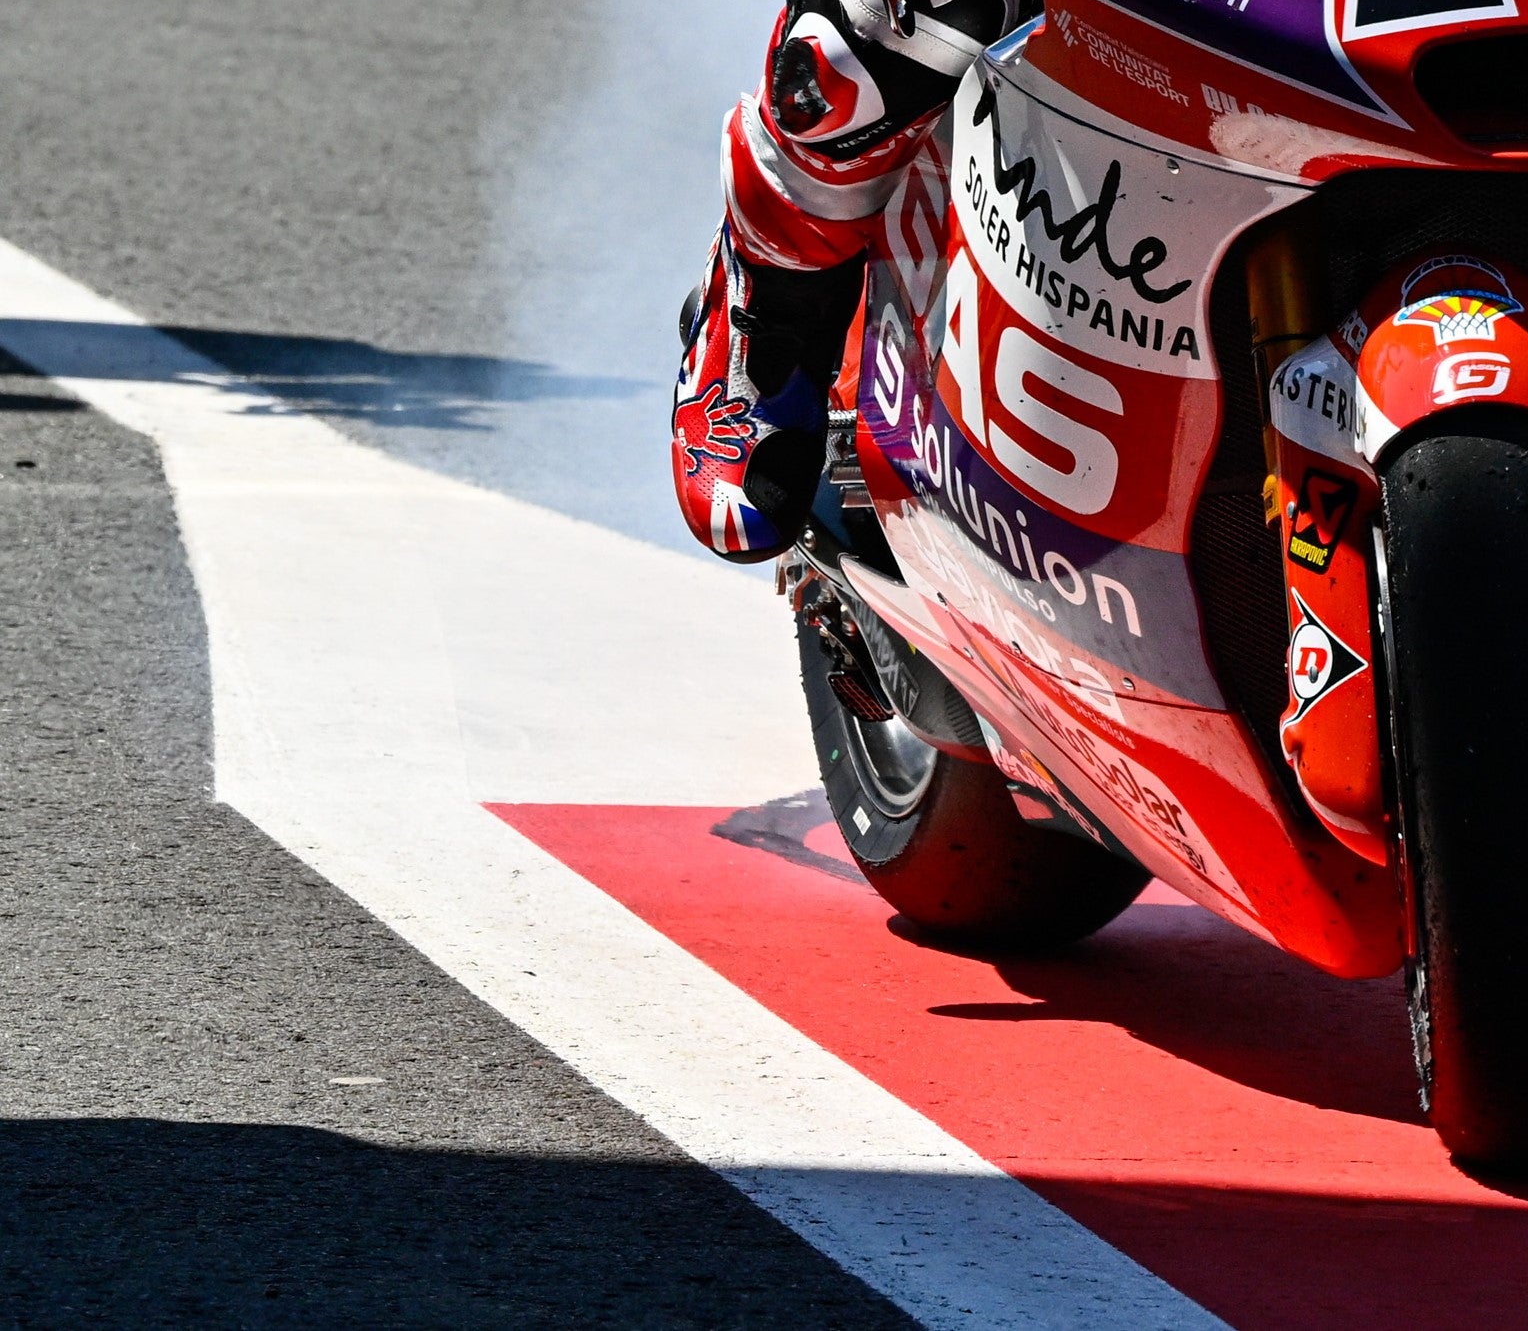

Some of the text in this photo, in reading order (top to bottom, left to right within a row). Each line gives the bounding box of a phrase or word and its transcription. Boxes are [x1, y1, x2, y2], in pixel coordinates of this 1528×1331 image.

[1077, 26, 1172, 87] COMUNITAT
[1089, 46, 1191, 108] DE L'ESPORT
[965, 155, 1201, 362] SOLER HISPANIA
[911, 393, 1142, 638] solunion
